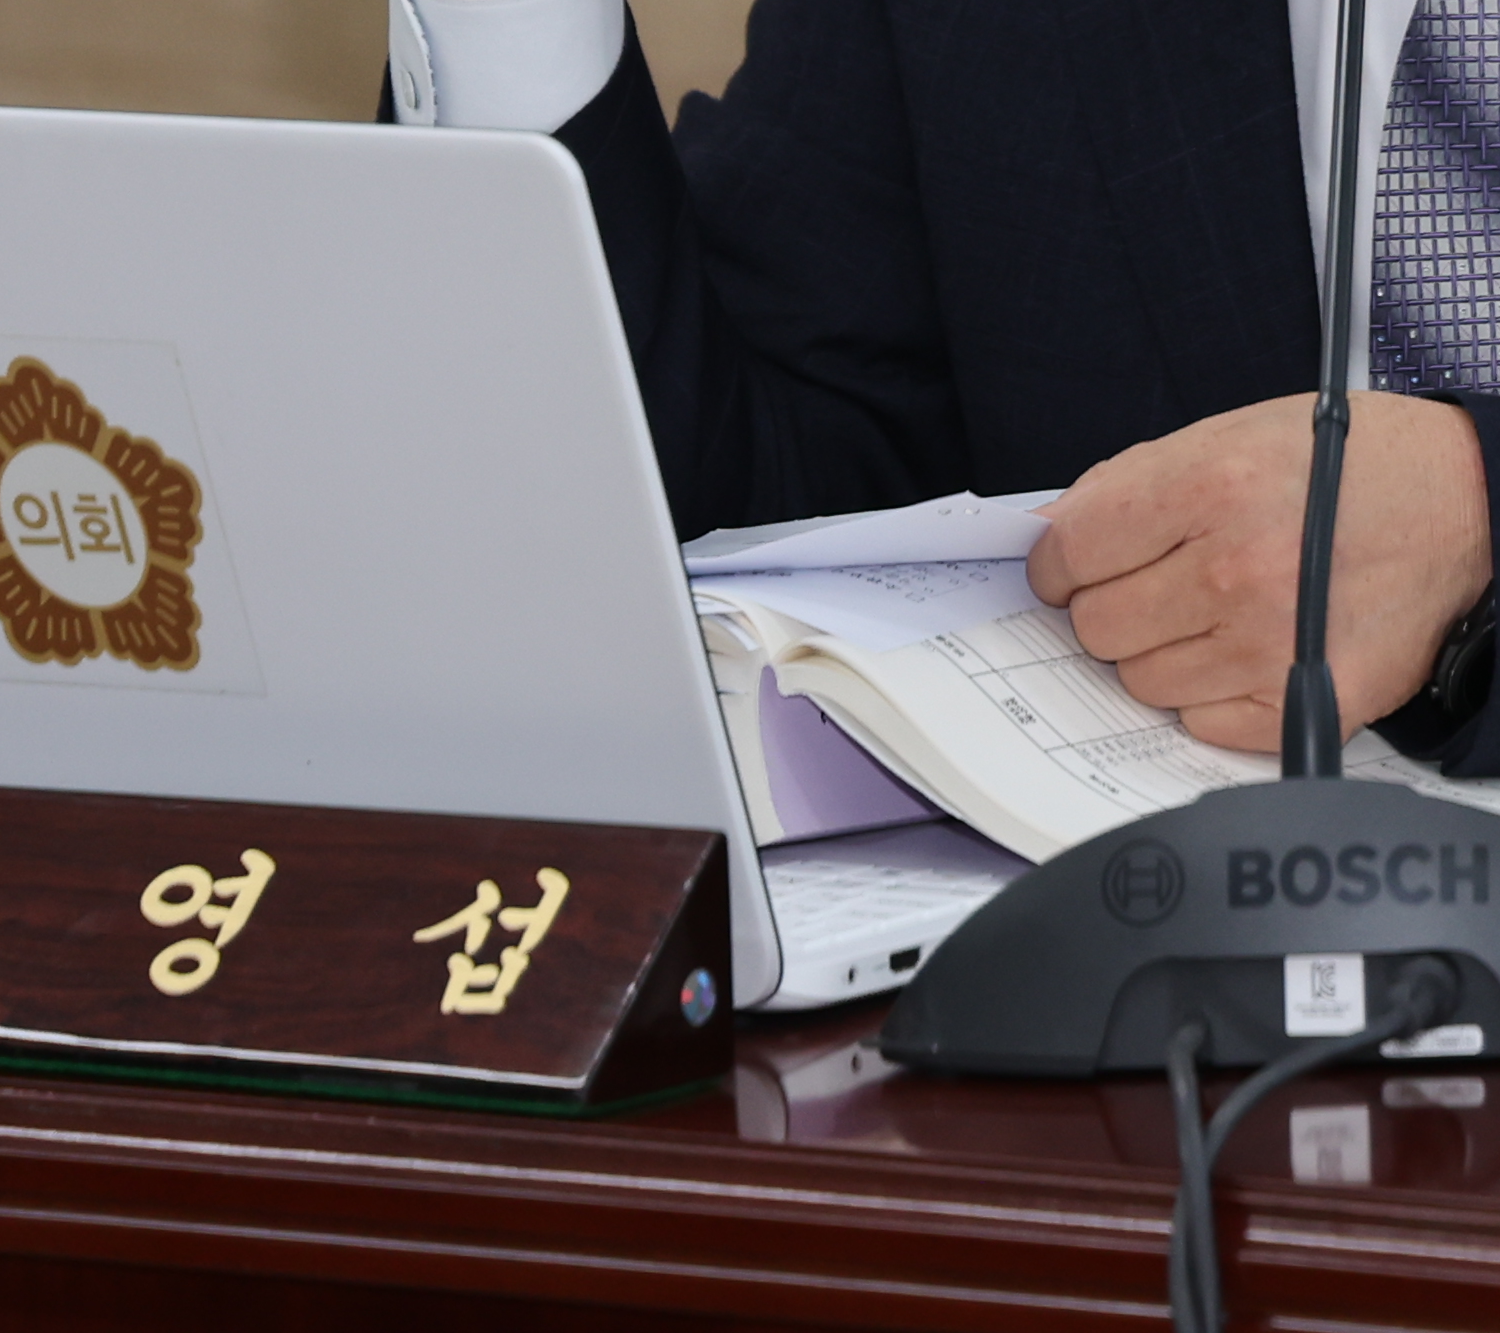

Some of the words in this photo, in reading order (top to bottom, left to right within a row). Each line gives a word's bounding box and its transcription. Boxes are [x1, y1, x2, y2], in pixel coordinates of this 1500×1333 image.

[12, 491, 136, 566] 의회
[1227, 844, 1490, 909] BOSCH
[140, 848, 276, 997] 영
[413, 867, 570, 1015] 섭
